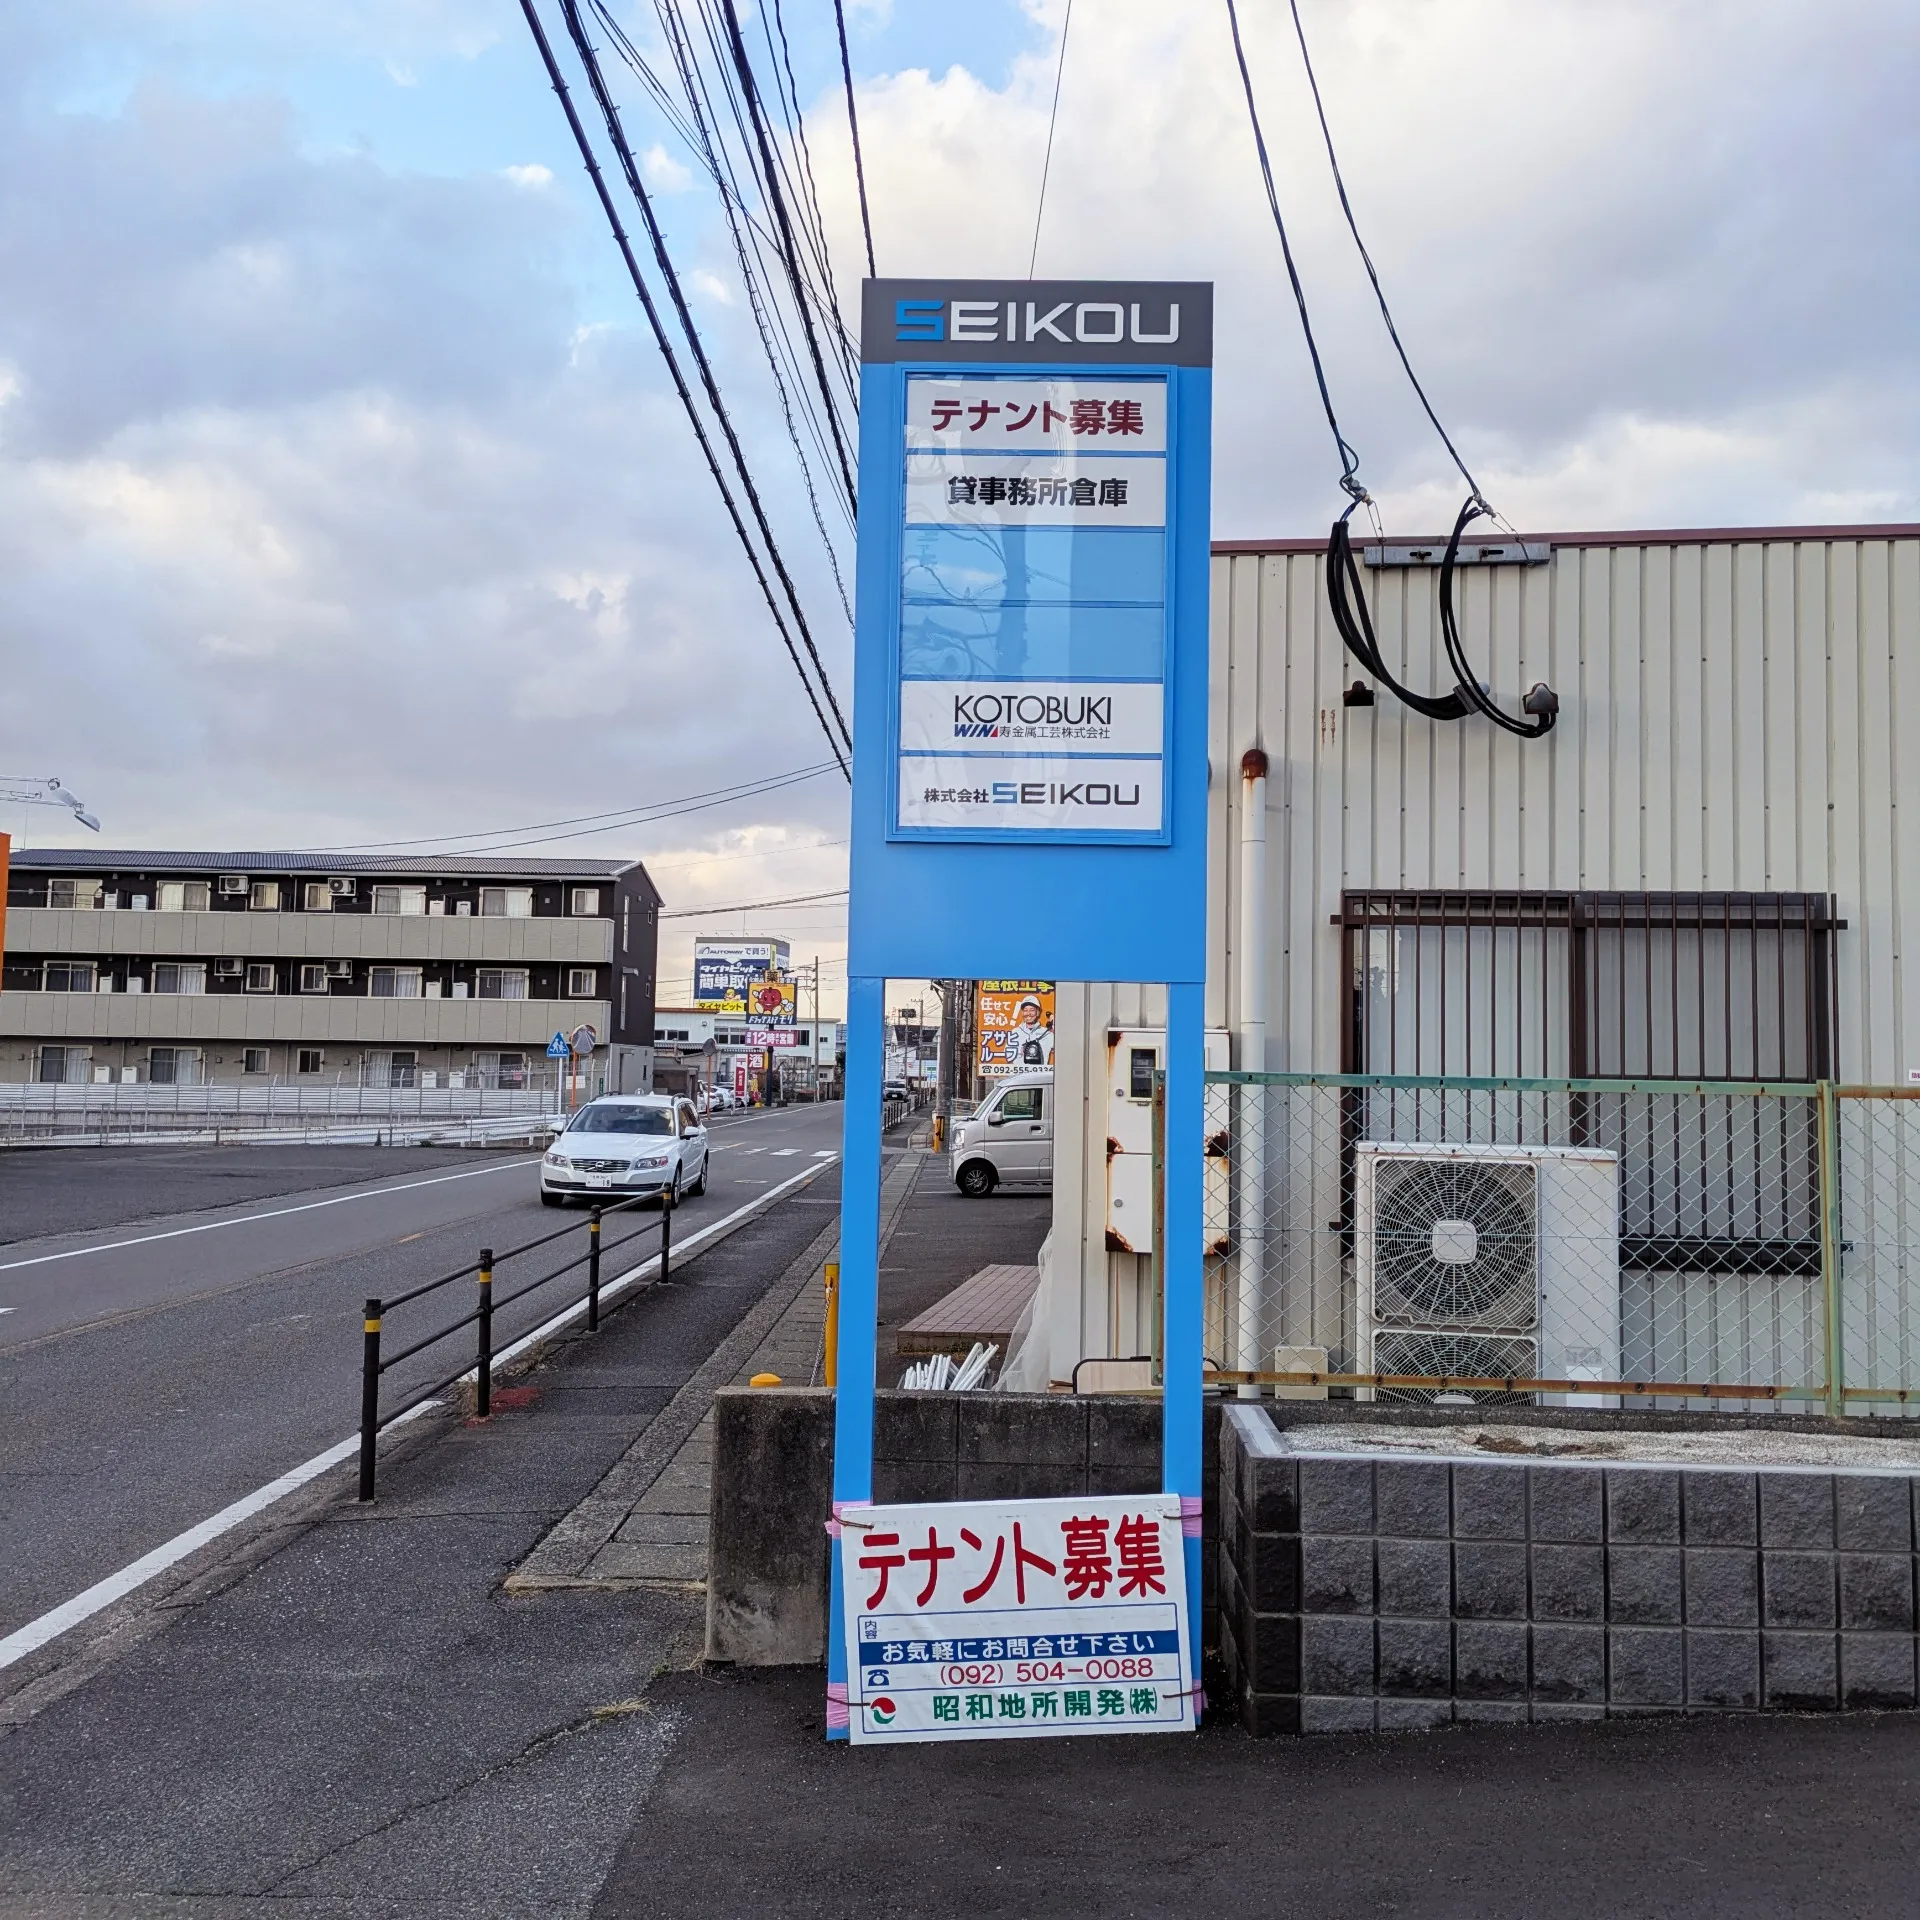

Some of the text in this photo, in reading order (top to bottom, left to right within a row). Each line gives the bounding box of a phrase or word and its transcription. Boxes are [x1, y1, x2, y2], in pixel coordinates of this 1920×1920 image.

[895, 300, 1180, 344] SEIKOU
[930, 399, 1145, 436] テナント募集
[947, 476, 1129, 508] 貸事務所倉庫
[954, 694, 1112, 725] KOTOBUKI
[999, 725, 1111, 740] 寿金属工芸株式会社
[700, 963, 757, 973] タイヤピット
[767, 971, 778, 983] 薬
[699, 1002, 743, 1011] タイヤピット
[980, 997, 1011, 1011] 任せて
[981, 1031, 1019, 1046] アサヒ
[749, 1053, 764, 1068] 酒
[980, 1047, 1018, 1062] ルーフ
[858, 1513, 1167, 1610] テナント募集
[864, 1620, 878, 1640] 内容
[881, 1634, 1155, 1663] お気軽にお問合せ下さい
